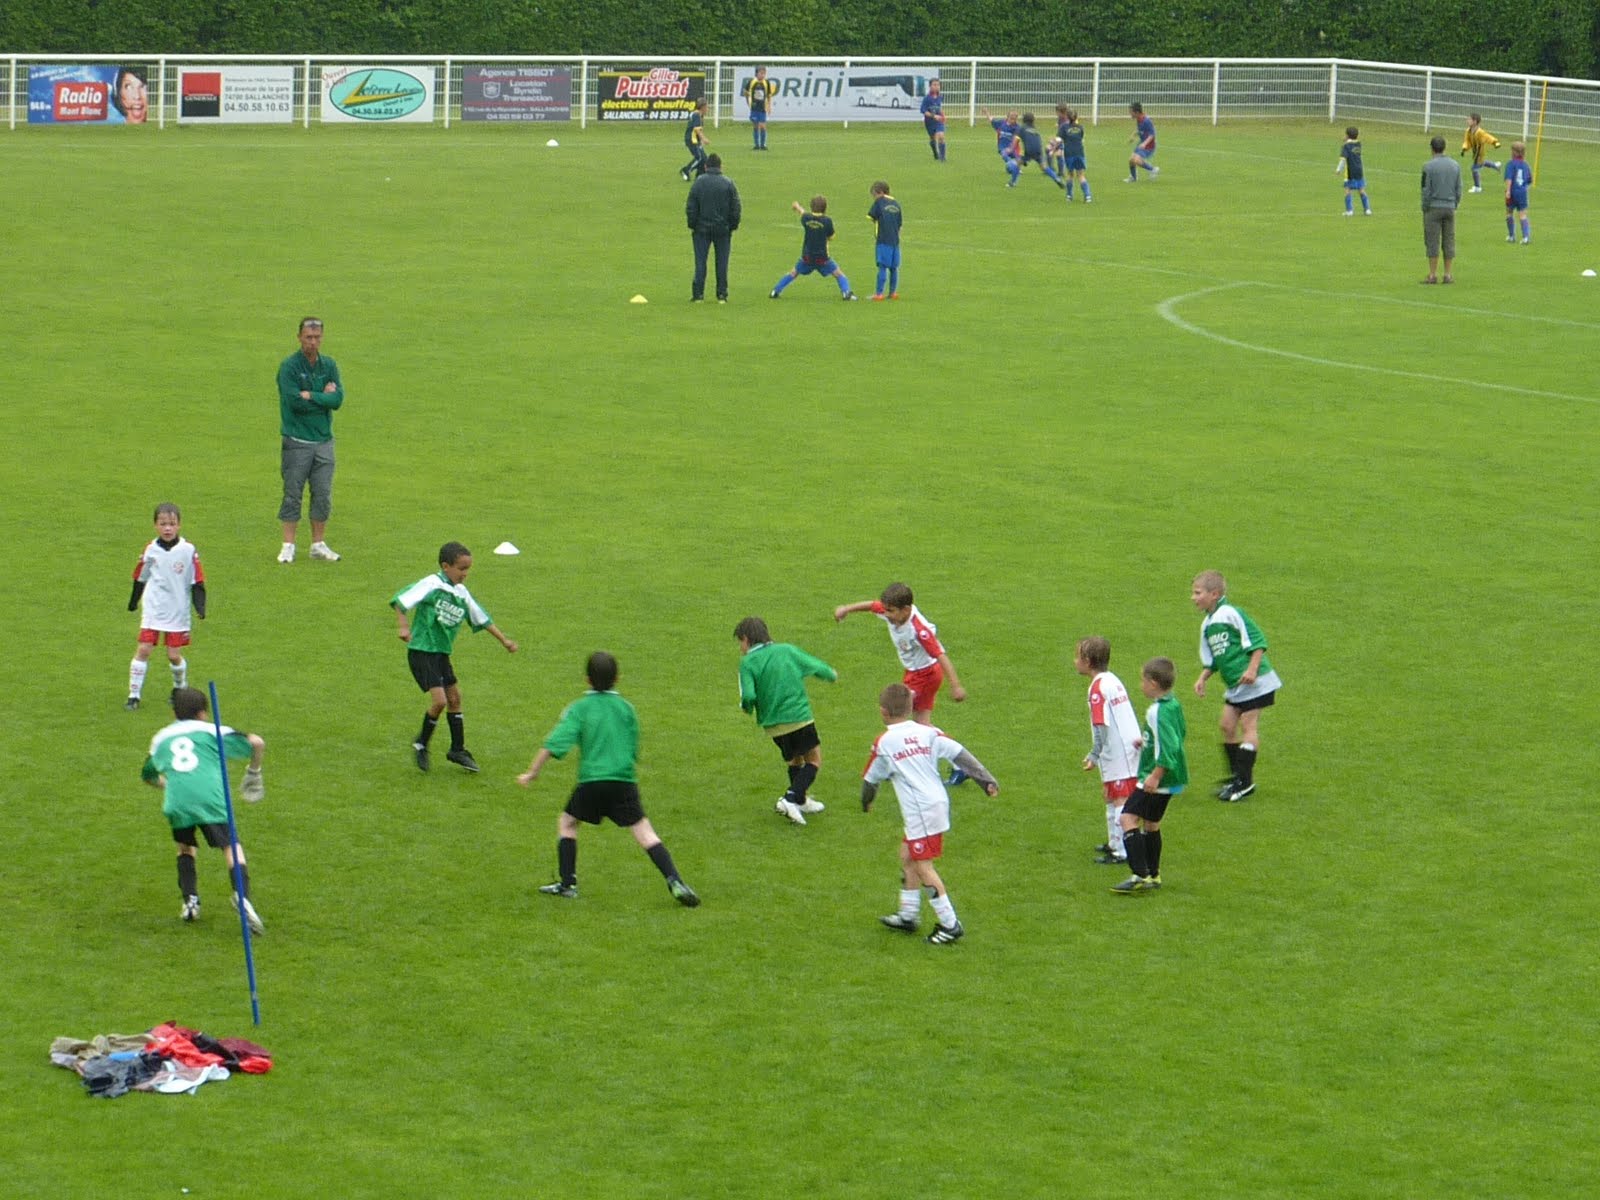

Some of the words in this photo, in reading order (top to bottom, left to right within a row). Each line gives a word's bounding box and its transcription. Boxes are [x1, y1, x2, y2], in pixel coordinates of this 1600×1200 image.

[480, 68, 516, 78] Agence
[518, 68, 555, 77] TISSOT
[649, 68, 680, 80] Gilles
[615, 76, 690, 98] Puissant
[60, 87, 102, 103] Radio
[60, 106, 79, 115] Mont
[81, 106, 102, 115] Blanc
[225, 103, 290, 112] 04.50.58.10.63
[602, 100, 649, 109] électricité
[653, 100, 697, 110] chauffag
[603, 111, 645, 119] SALLANCHES
[649, 111, 659, 119] 04
[1515, 169, 1524, 185] 4
[170, 736, 199, 772] 8
